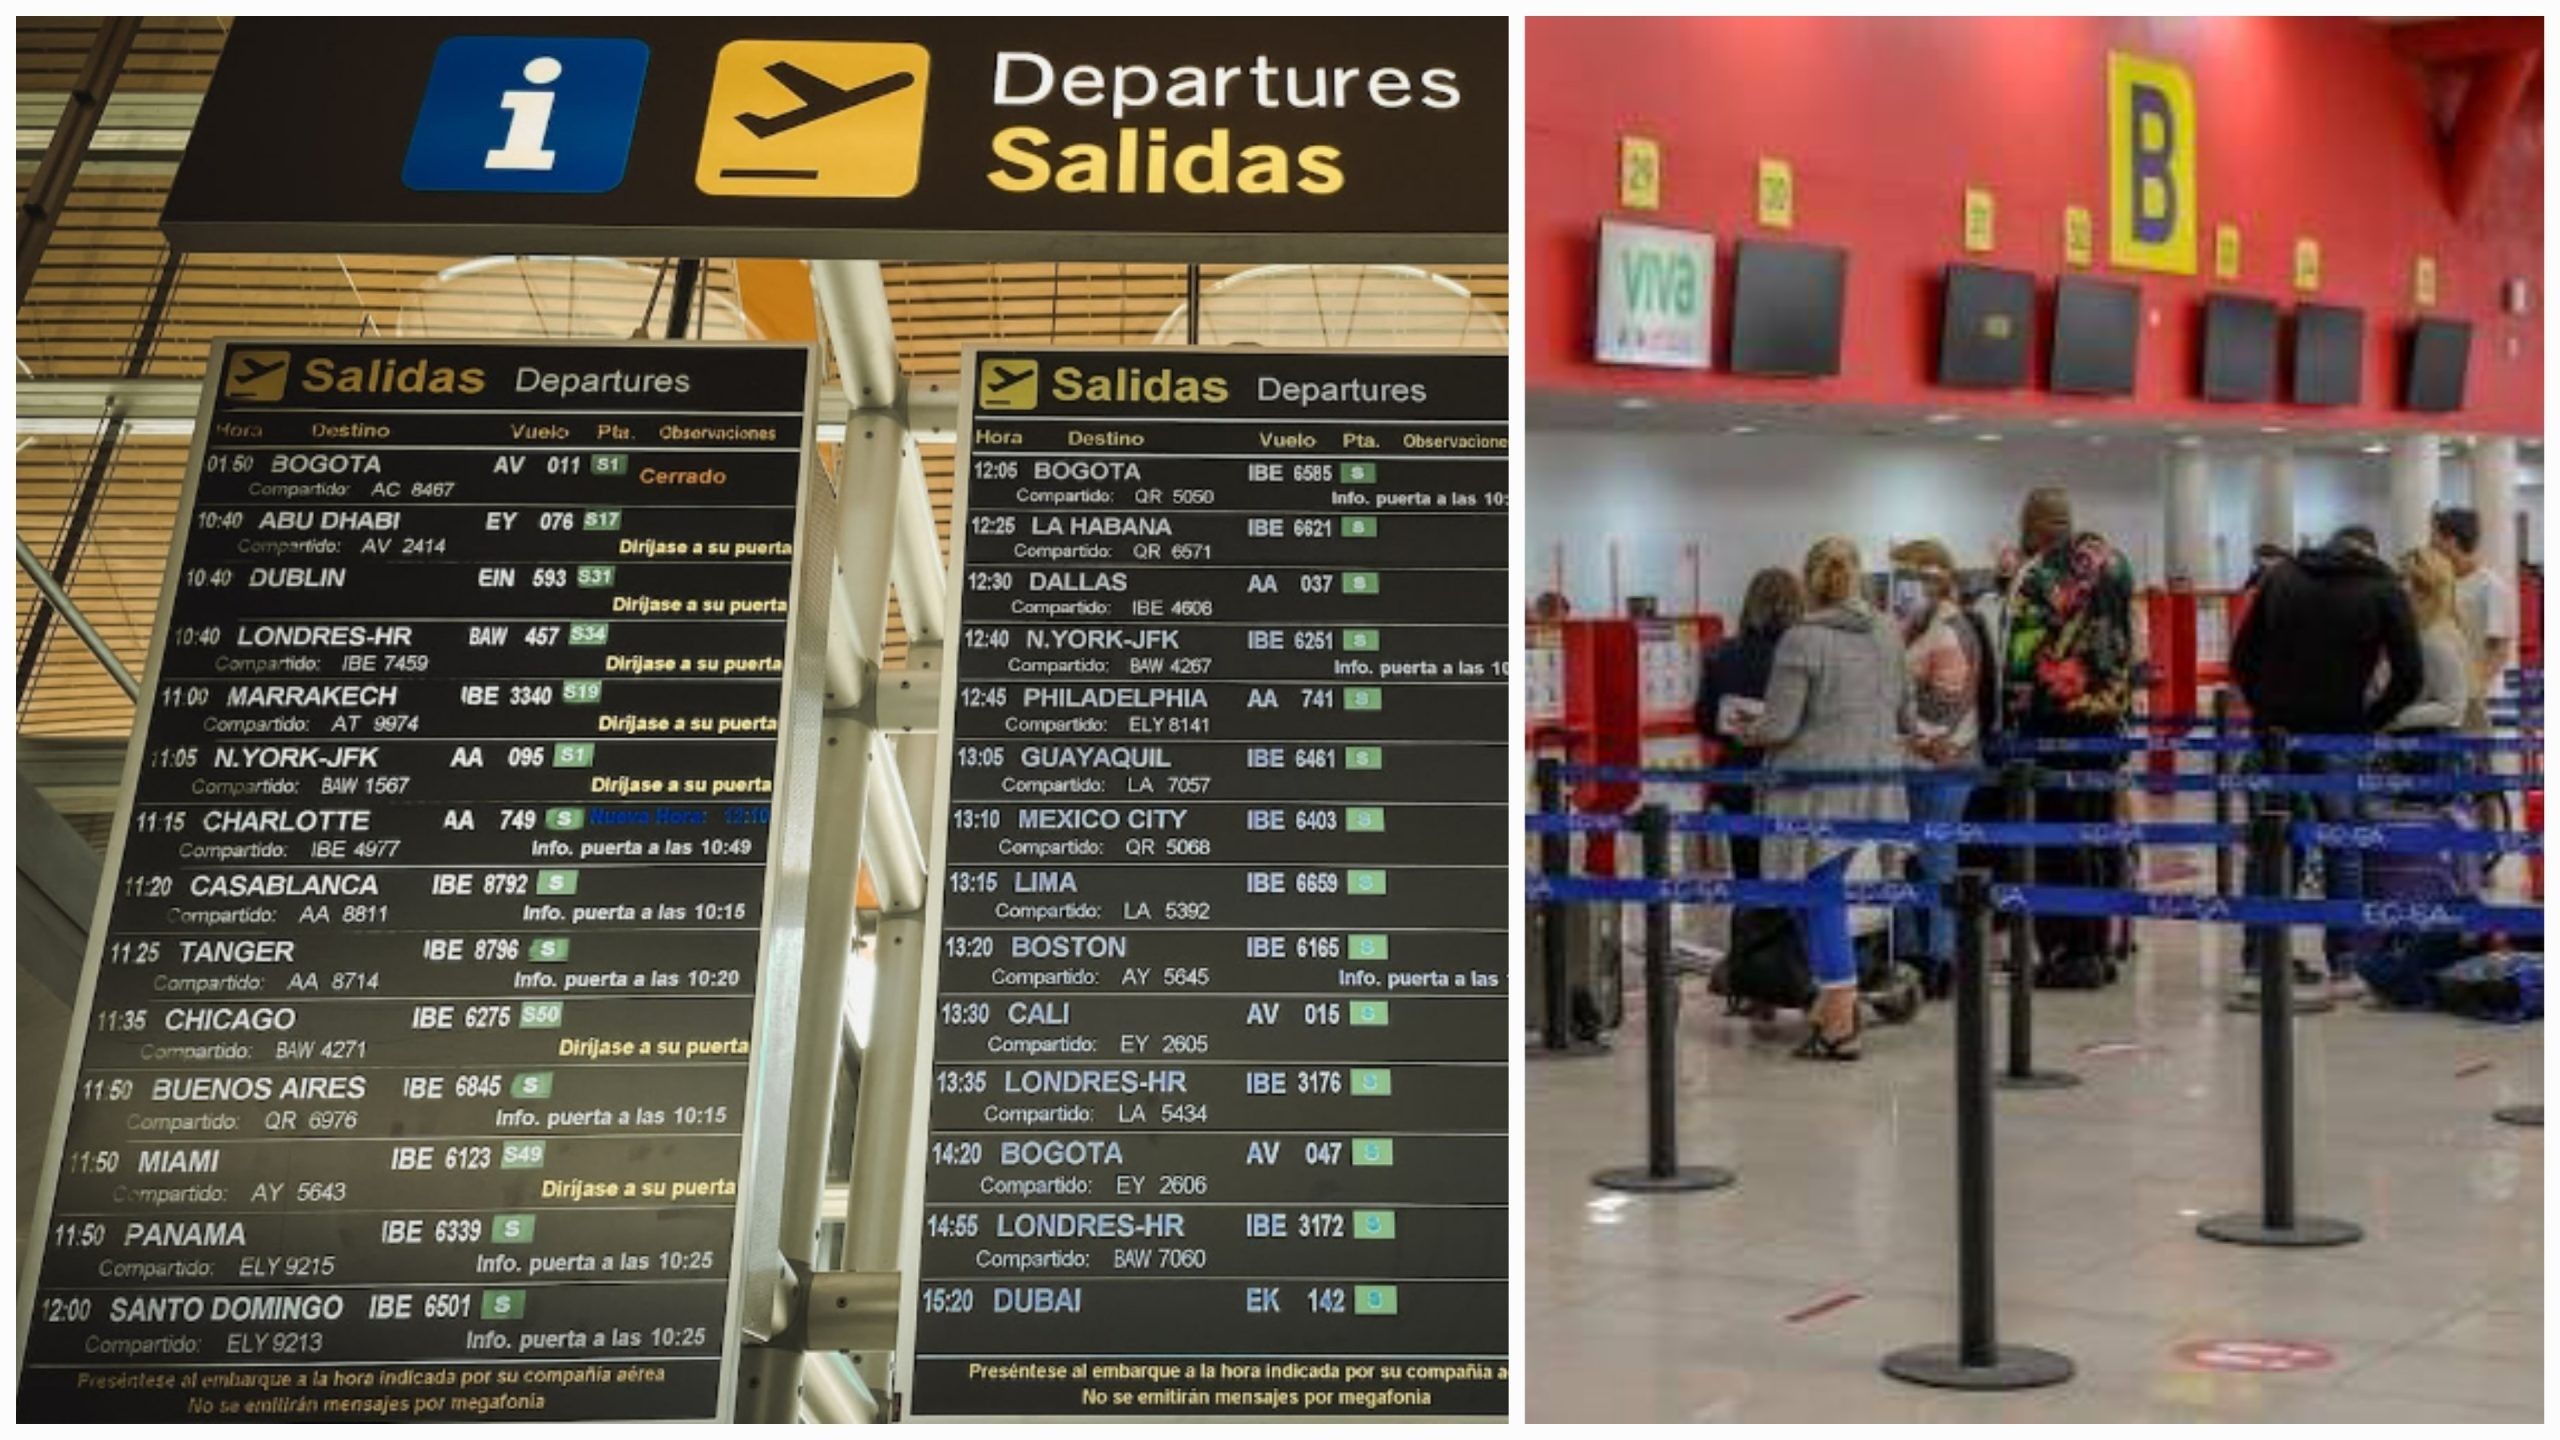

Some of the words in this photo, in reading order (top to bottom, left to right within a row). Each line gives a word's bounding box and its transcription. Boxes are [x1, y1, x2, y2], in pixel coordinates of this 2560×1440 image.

[994, 52, 1460, 119] Departures
[987, 127, 1344, 194] Salidas
[2131, 82, 2176, 244] B
[303, 359, 485, 394] Salidas
[516, 367, 690, 397] Departures
[1053, 367, 1228, 403] Salidas
[1258, 377, 1426, 407] Departures
[313, 423, 390, 437] Destino
[511, 425, 569, 439] Vuelo
[660, 425, 776, 440] Observaciones
[976, 430, 1022, 444] Hora
[1068, 431, 1144, 445] Destino
[1260, 432, 1317, 447] Vuelo
[1343, 433, 1379, 448] Pta.
[272, 454, 381, 473] BOGOTA
[494, 456, 526, 473] AV
[548, 456, 579, 474] 011
[975, 461, 1017, 479] 12:05
[1035, 462, 1141, 480] BOGOTA
[1249, 464, 1283, 481] IBE
[640, 468, 726, 484] Cerrado
[259, 512, 314, 530] ABU
[321, 512, 400, 530] DHABI
[486, 512, 518, 530] EY
[540, 512, 573, 530] 076
[972, 516, 1015, 534] 12:25
[1032, 517, 1064, 535] LA
[1071, 517, 1172, 535] HABANA
[1249, 519, 1283, 536] IBE
[1294, 519, 1330, 537] 6621
[249, 568, 346, 587] DUBLIN
[479, 568, 514, 586] EIN
[532, 568, 566, 587] 593
[968, 572, 1012, 590] 12:30
[1030, 572, 1127, 591] DALLAS
[1248, 575, 1277, 592] AA
[1301, 575, 1332, 592] 037
[238, 626, 412, 646] LONDRES-HR
[469, 627, 508, 645] BAW
[525, 626, 560, 645] 457
[965, 629, 1009, 648] 12:40
[1027, 629, 1179, 649] N.YORK-JFK
[1249, 631, 1283, 649] IBE
[1295, 631, 1332, 649] 6251
[227, 686, 397, 706] MARRAKECH
[461, 686, 499, 705] IBE
[510, 686, 552, 705] 3340
[961, 688, 1006, 707] 12:45
[1024, 688, 1208, 707] PHILADELPHIA
[1247, 689, 1279, 707] AA
[1302, 689, 1332, 707] 741
[215, 747, 379, 767] N.YORK-JFK
[450, 747, 483, 767] AA
[508, 747, 544, 766] 095
[958, 747, 1004, 766] 13:05
[1021, 747, 1171, 769] GUAYAQUIL
[1248, 749, 1284, 767] IBE
[138, 812, 186, 832] 11:15
[204, 810, 371, 832] CHARLOTTE
[444, 810, 474, 830] AA
[501, 810, 536, 830] 749
[954, 809, 999, 828] 13:10
[1019, 809, 1120, 829] MEXICO
[1128, 809, 1187, 829] CITY
[1248, 810, 1285, 829] IBE
[1296, 811, 1336, 829] 6403
[191, 874, 378, 896] CASABLANCA
[432, 874, 472, 894] IBE
[484, 874, 528, 894] 8792
[950, 872, 997, 892] 13:15
[1015, 872, 1077, 892] LIMA
[1248, 872, 1285, 892] IBE
[523, 905, 565, 920] Info.
[572, 905, 635, 924] puerta
[641, 908, 652, 919] a
[658, 904, 686, 920] las
[695, 903, 745, 919] 10:15
[995, 903, 1101, 922] Compartido:
[1124, 902, 1151, 919] LA
[1166, 902, 1210, 919] 5392
[180, 941, 294, 963] TANGER
[424, 939, 463, 960] IBE
[474, 939, 519, 960] 8796
[946, 937, 993, 957] 13:20
[1012, 936, 1126, 957] BOSTON
[1248, 937, 1285, 957] IBE
[1297, 937, 1339, 957] 6165
[166, 1008, 295, 1030] CHICAGO
[413, 1007, 454, 1028] IBE
[466, 1006, 510, 1027] 6275
[942, 1003, 989, 1024] 13:30
[1008, 1002, 1069, 1024] CALI
[1247, 1003, 1279, 1024] AV
[1305, 1004, 1339, 1024] 015
[152, 1078, 272, 1100] BUENOS
[279, 1076, 366, 1099] AIRES
[404, 1078, 444, 1098] IBE
[456, 1075, 501, 1097] 6845
[937, 1071, 986, 1093] 13:35
[1005, 1071, 1187, 1093] LONDRES-HR
[1247, 1072, 1286, 1093] IBE
[1298, 1071, 1341, 1093] 3176
[139, 1150, 219, 1172] MIAMI
[391, 1147, 434, 1169] IBE
[445, 1147, 491, 1169] 6123
[932, 1142, 982, 1165] 14:20
[1002, 1140, 1123, 1165] BOGOTA
[1247, 1142, 1280, 1164] AV
[1305, 1142, 1342, 1164] 047
[624, 1183, 635, 1196] a
[642, 1183, 665, 1196] su
[672, 1178, 735, 1200] puerta
[124, 1222, 245, 1246] PANAMA
[382, 1220, 423, 1243] IBE
[436, 1219, 481, 1242] 6339
[928, 1214, 978, 1237] 14:55
[997, 1213, 1184, 1237] LONDRES-HR
[1247, 1214, 1287, 1236] IBE
[1299, 1214, 1343, 1236] 3172
[976, 1250, 1089, 1272] Compartido:
[1115, 1249, 1152, 1268] BAW
[1158, 1249, 1206, 1268] 7060
[110, 1297, 204, 1322] SANTO
[211, 1295, 343, 1321] DOMINGO
[369, 1294, 412, 1318] IBE
[425, 1294, 470, 1317] 6501
[923, 1288, 973, 1312] 15:20
[994, 1288, 1081, 1312] DUBAI
[1247, 1288, 1279, 1312] EK
[1308, 1288, 1345, 1312] 142
[1072, 1364, 1086, 1378] al
[1093, 1363, 1180, 1382] embarque
[1185, 1366, 1195, 1378] a
[1201, 1363, 1215, 1378] la
[1221, 1364, 1261, 1378] hora
[1266, 1364, 1339, 1378] indicada
[1346, 1366, 1374, 1382] por
[1381, 1367, 1401, 1378] su
[1083, 1389, 1107, 1404] No
[1114, 1393, 1132, 1404] se
[1215, 1388, 1299, 1408] mensajes
[1305, 1392, 1333, 1408] por
